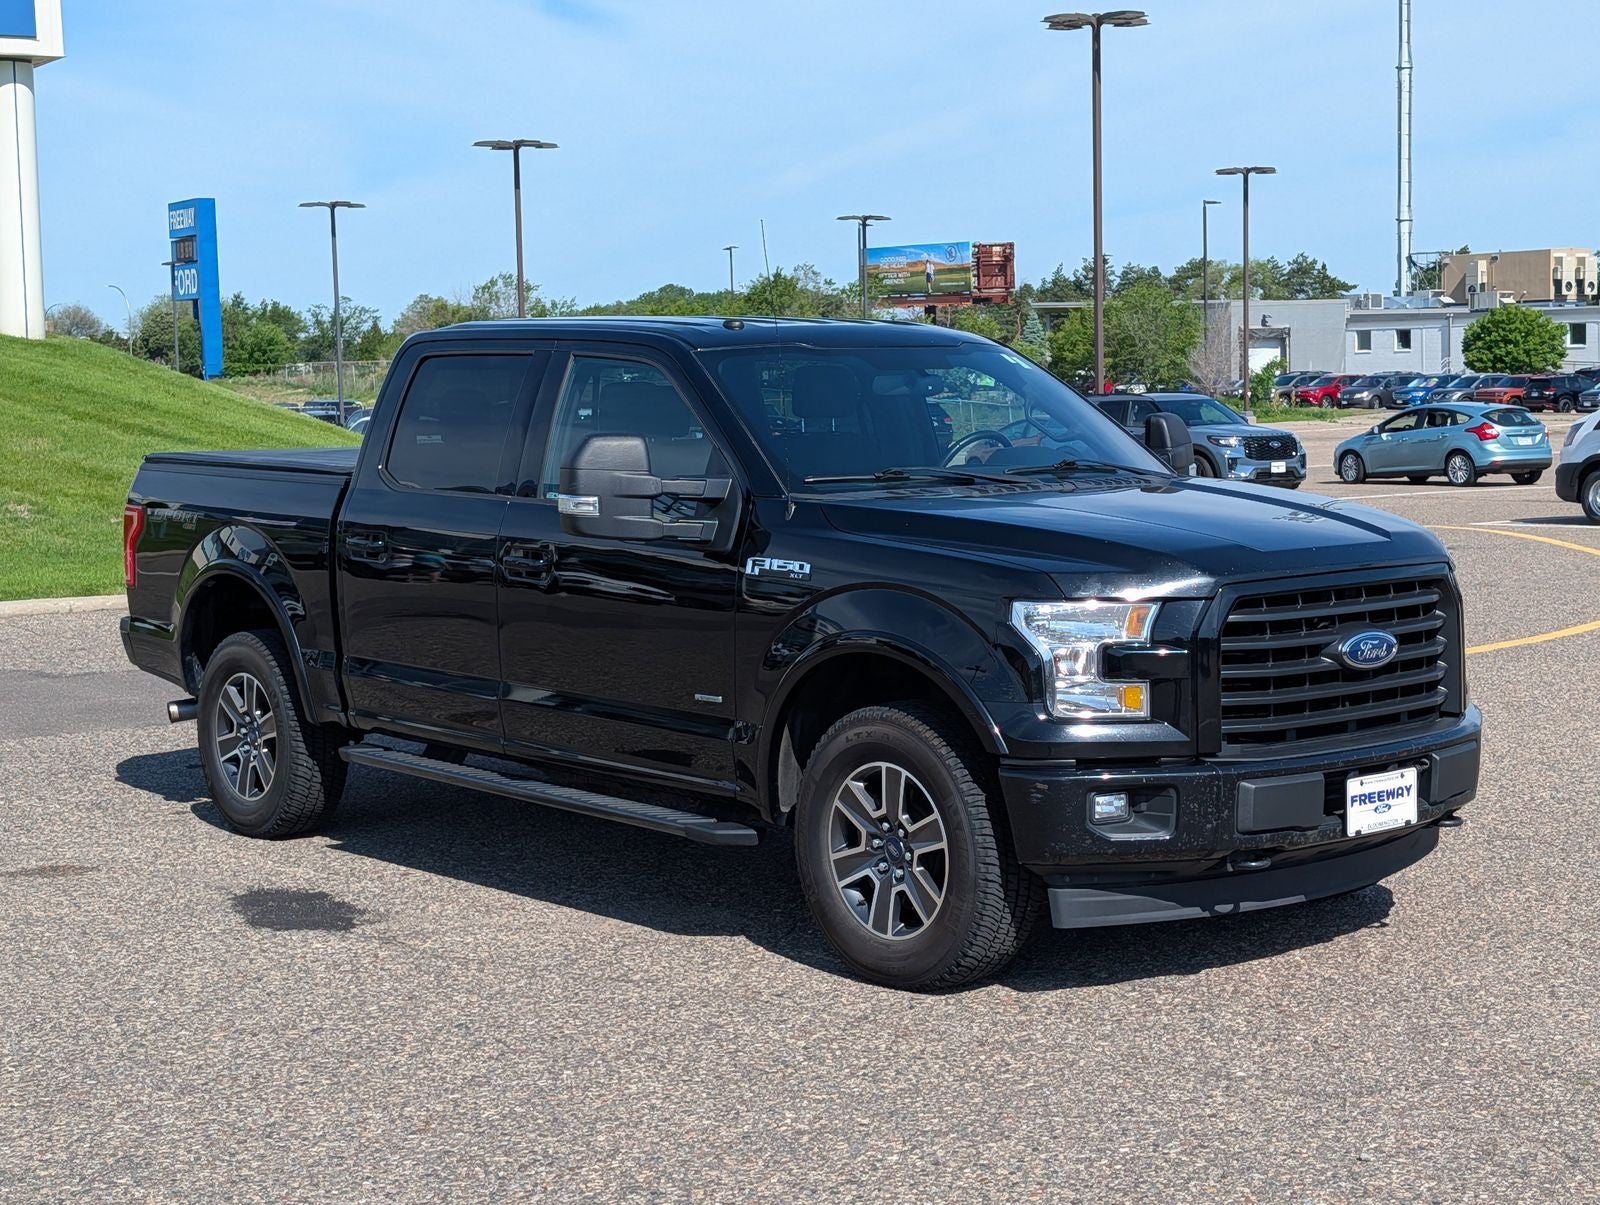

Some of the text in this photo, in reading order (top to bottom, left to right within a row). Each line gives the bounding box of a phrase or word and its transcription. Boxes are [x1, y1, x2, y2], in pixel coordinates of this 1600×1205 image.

[170, 207, 195, 230] FREEWAY
[1357, 639, 1388, 661] Ford
[1350, 784, 1413, 808] FREEWAY
